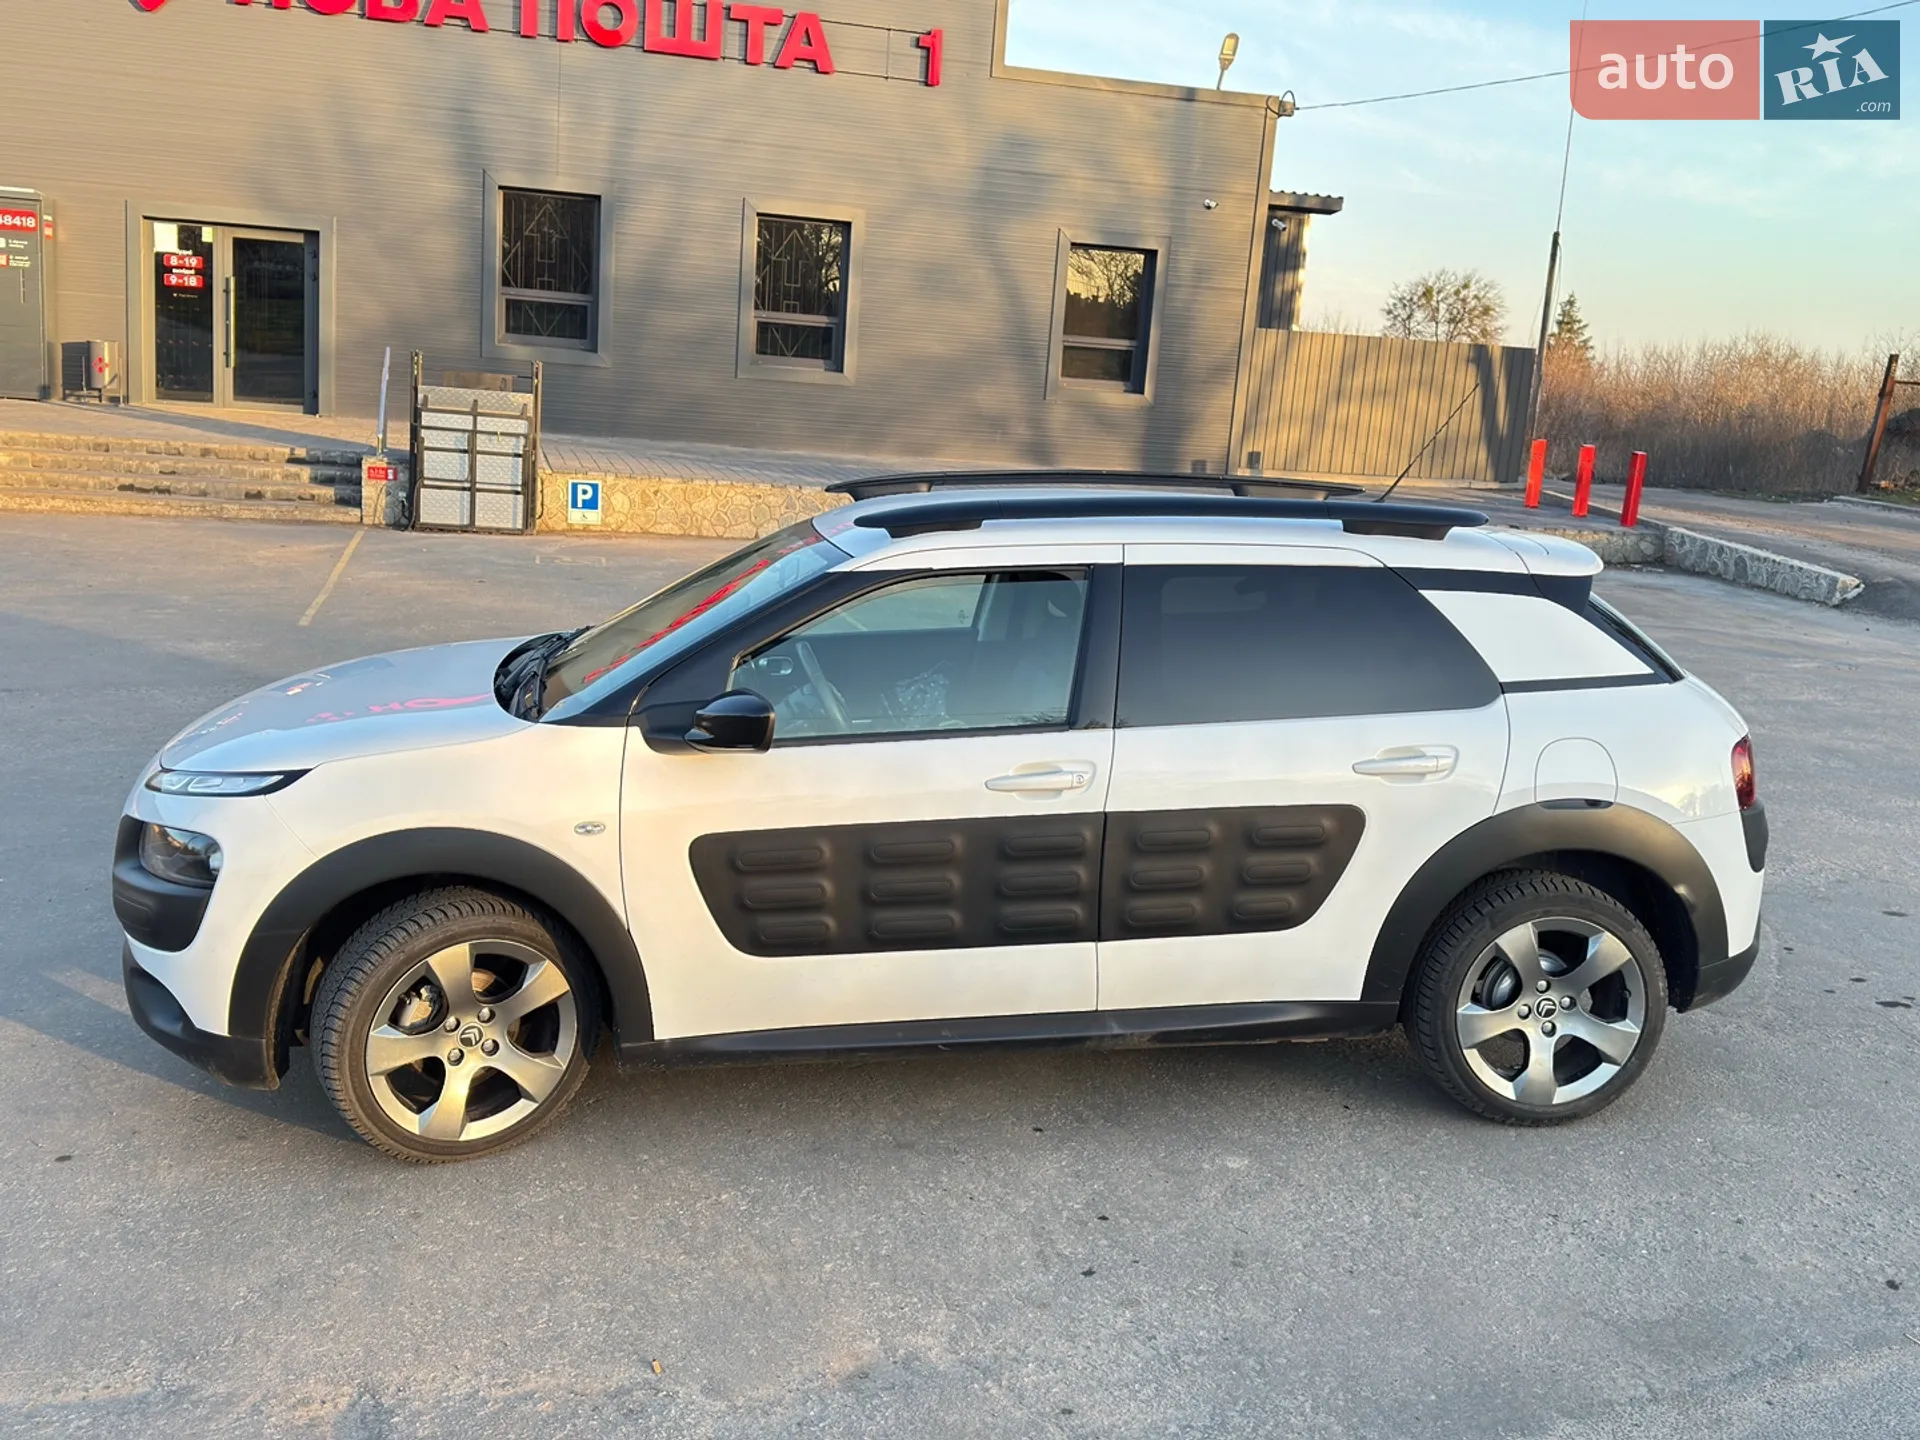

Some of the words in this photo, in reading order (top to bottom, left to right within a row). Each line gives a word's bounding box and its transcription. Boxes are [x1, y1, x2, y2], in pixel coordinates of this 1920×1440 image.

[519, 0, 835, 74] ПОШТА
[918, 28, 943, 86] 1
[170, 255, 198, 268] 8-19
[170, 274, 197, 287] 9-18
[577, 484, 593, 508] P
